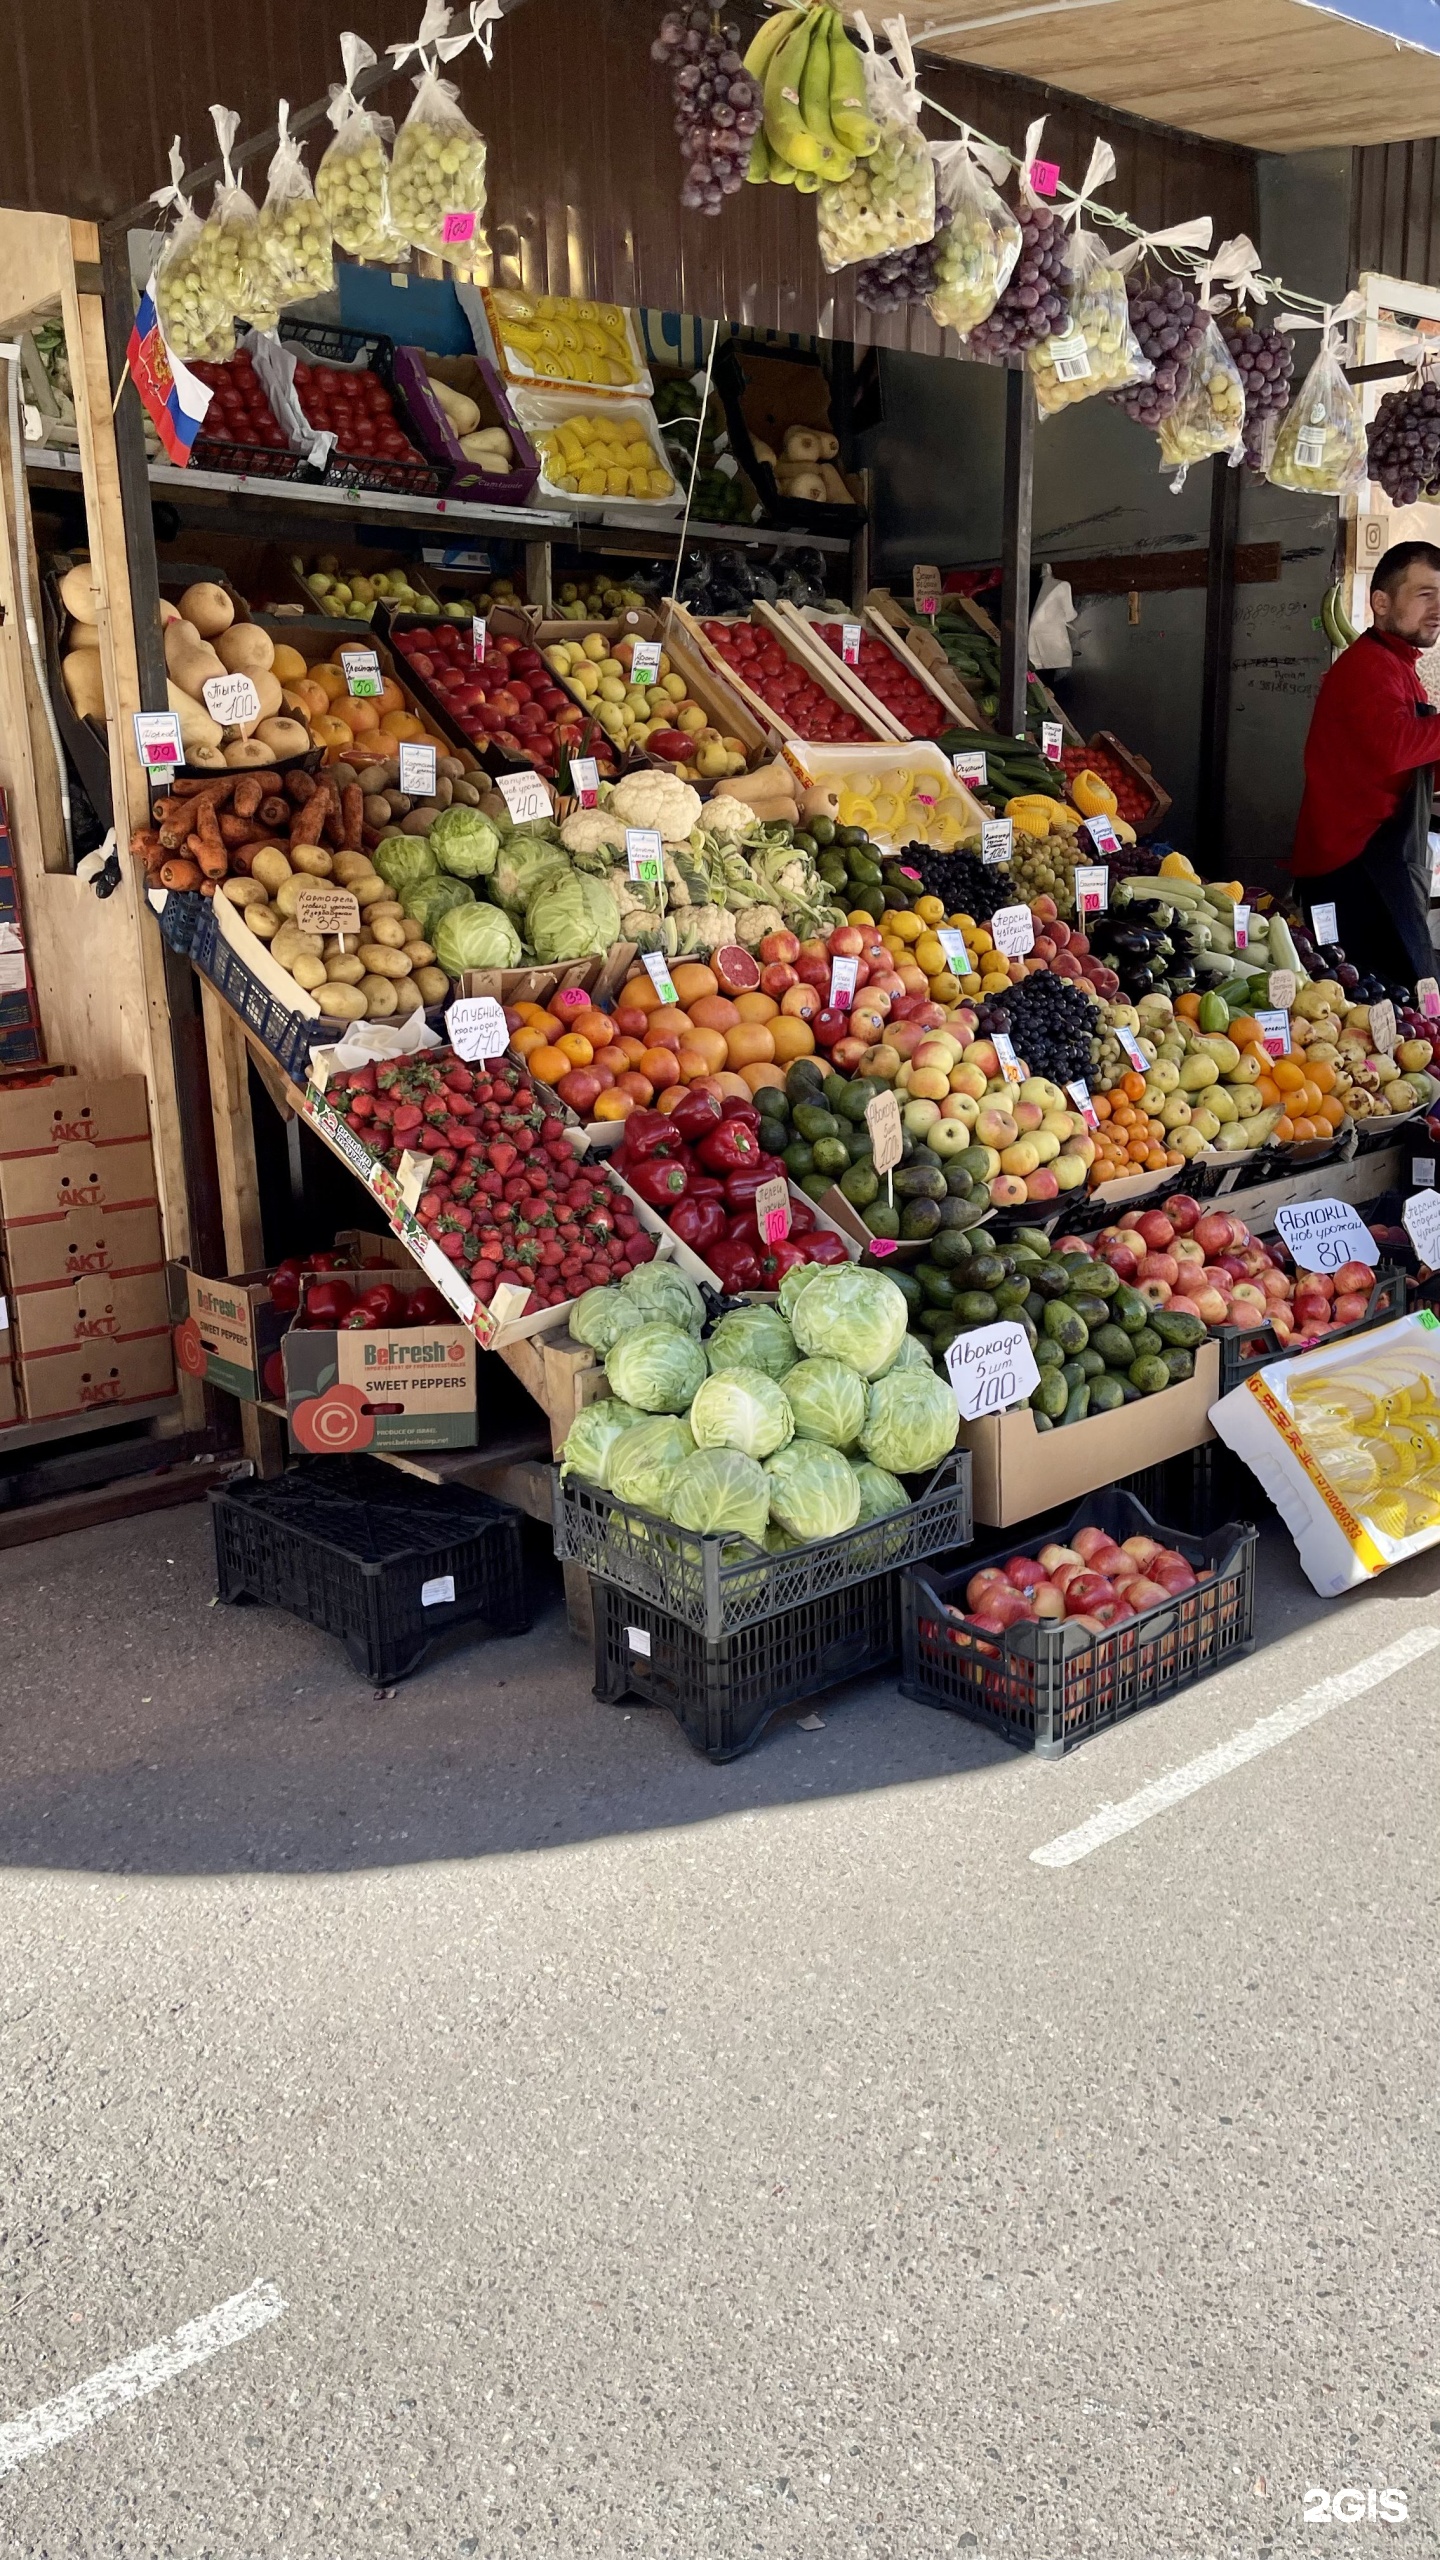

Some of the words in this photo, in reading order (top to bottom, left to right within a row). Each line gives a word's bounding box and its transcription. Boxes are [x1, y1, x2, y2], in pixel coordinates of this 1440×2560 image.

[354, 679, 370, 694] 50
[153, 745, 171, 761] 50
[644, 861, 658, 881] 50
[52, 1120, 95, 1142] AKT
[59, 1185, 101, 1206] AKT
[1290, 1230, 1313, 1243] нов
[1315, 1217, 1362, 1240] урожай
[66, 1251, 108, 1273] AKT
[75, 1316, 116, 1338] AKT
[200, 1320, 219, 1335] SWEET
[221, 1326, 248, 1346] PEPPERS
[364, 1340, 445, 1366] BeFresh
[81, 1379, 121, 1402] AKT
[366, 1380, 409, 1392] SWEET
[412, 1376, 467, 1390] PEPPERS
